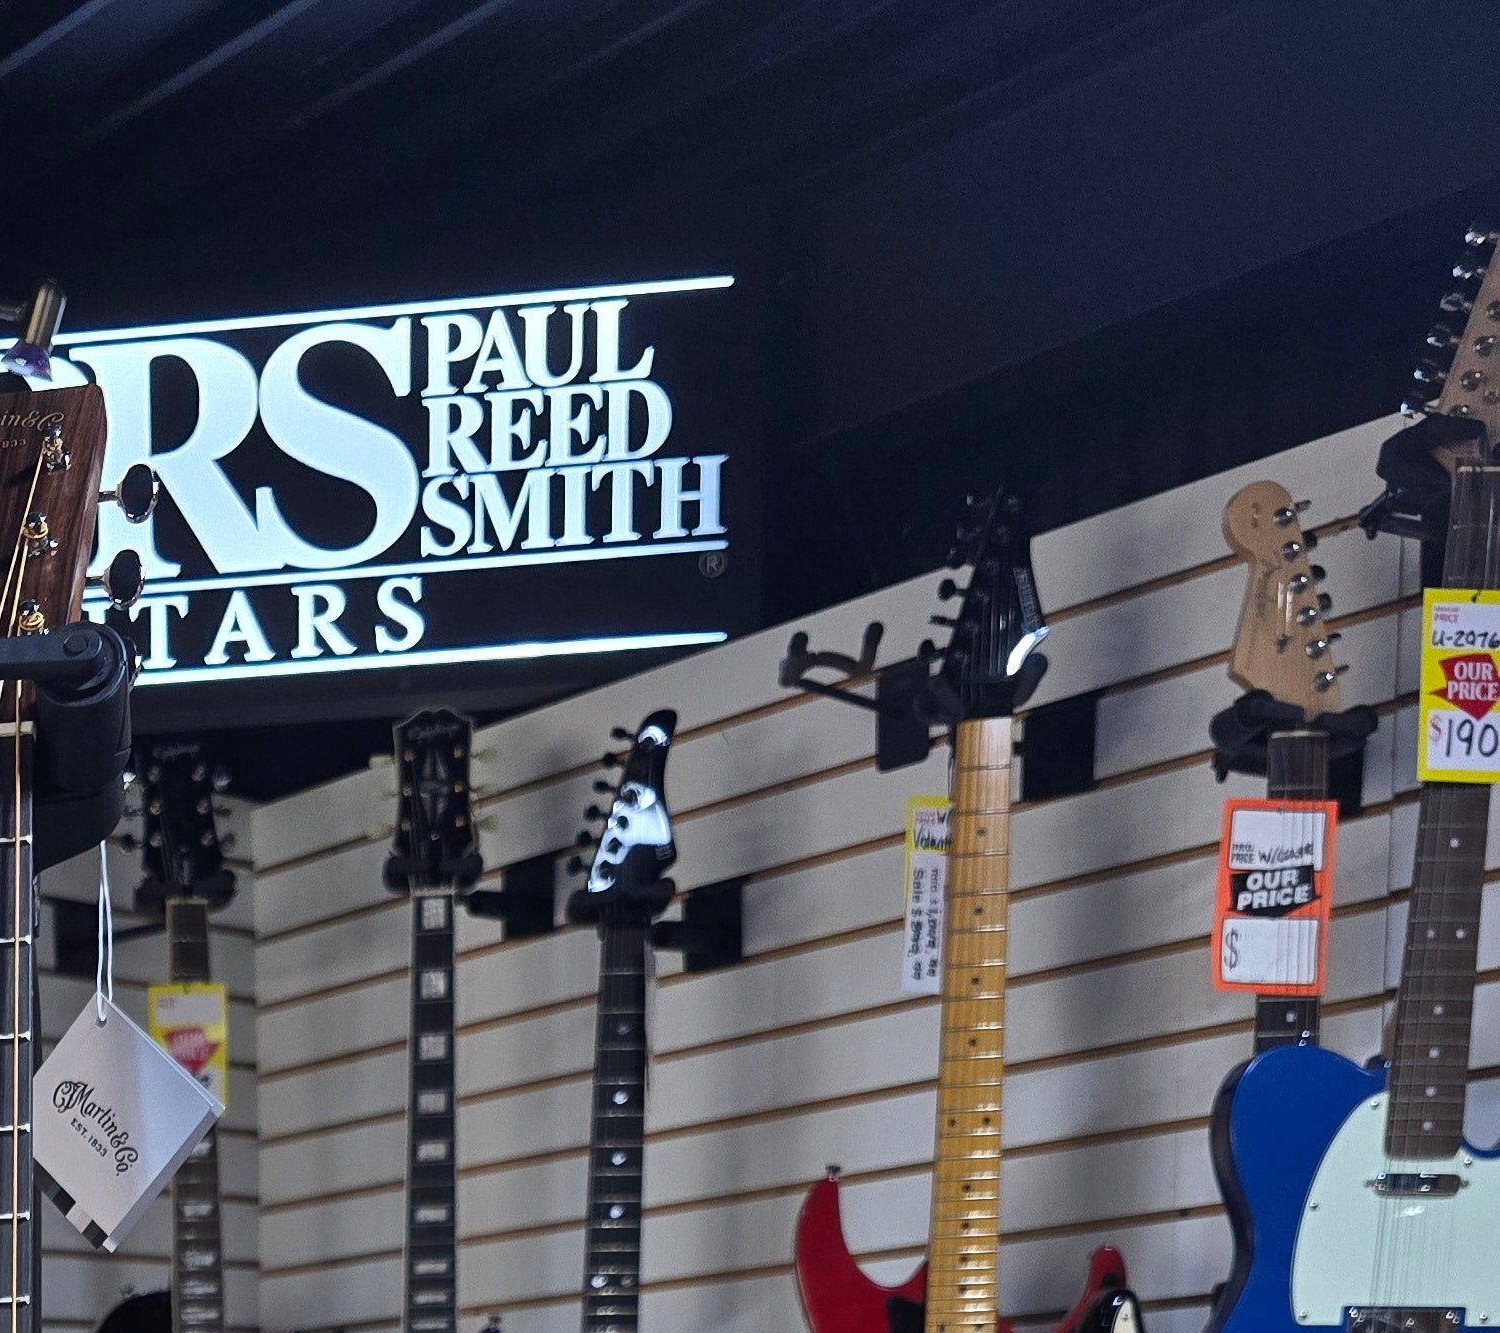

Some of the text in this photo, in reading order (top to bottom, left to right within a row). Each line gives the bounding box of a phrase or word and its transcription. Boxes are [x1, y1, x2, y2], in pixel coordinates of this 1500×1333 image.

[421, 298, 654, 398] PAUL
[422, 381, 672, 479] REED
[420, 455, 729, 558] SMITH
[1447, 681, 1500, 701] PRICE
[1453, 661, 1493, 682] OUR
[1236, 883, 1312, 911] PRICE
[1245, 868, 1300, 891] OUR
[1224, 927, 1240, 971] $
[70, 1117, 108, 1158] EST. 1833
